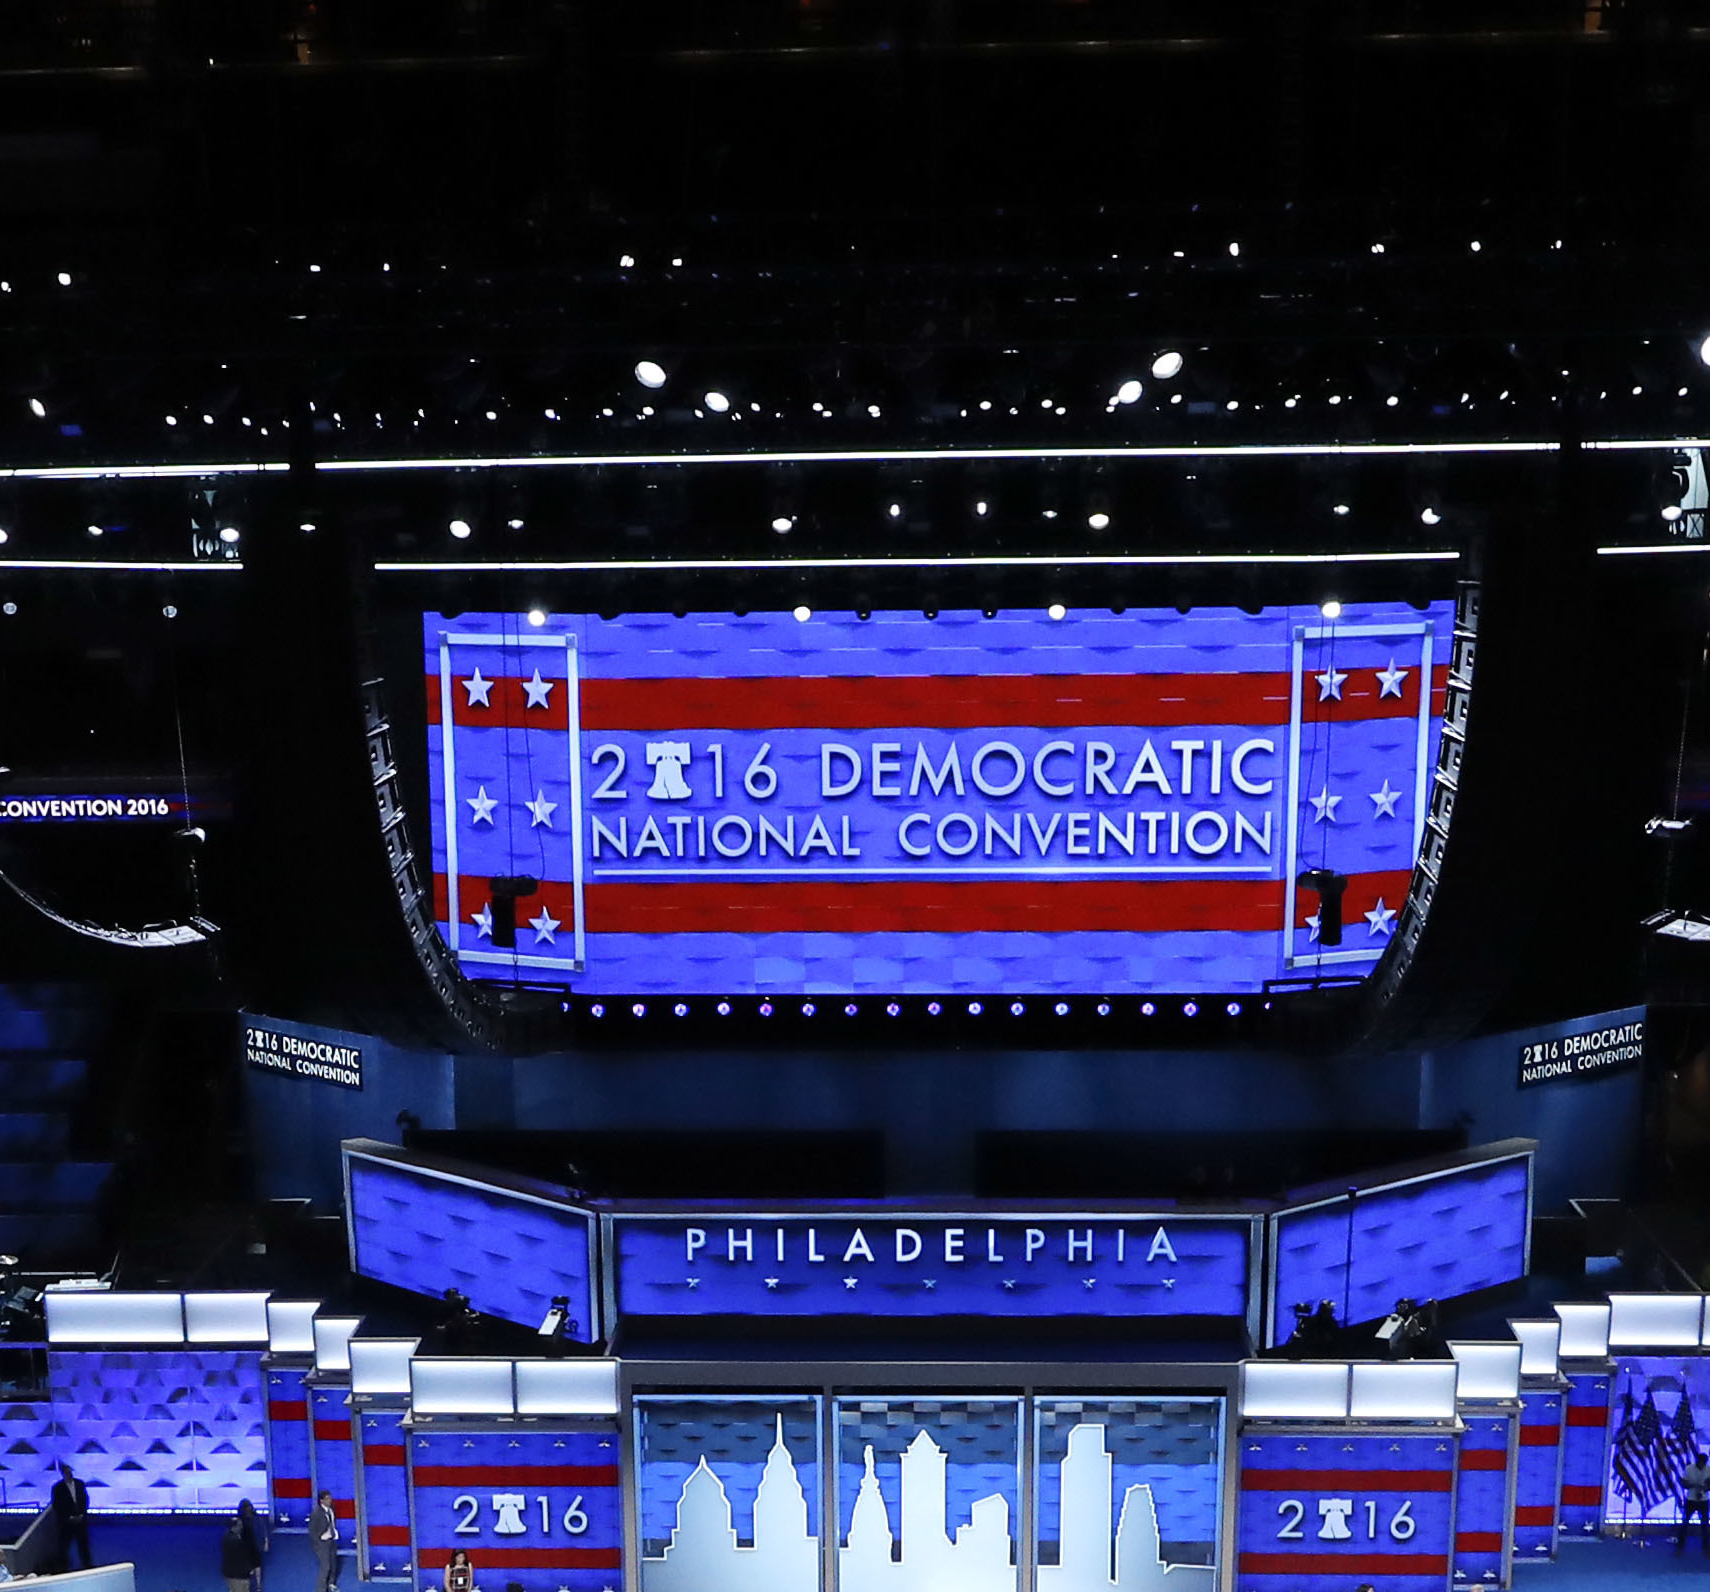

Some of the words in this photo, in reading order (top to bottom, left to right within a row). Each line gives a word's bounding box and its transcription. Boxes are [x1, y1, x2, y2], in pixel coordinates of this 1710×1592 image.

[821, 738, 1275, 797] DEMOCRATIC
[127, 799, 169, 815] 2016
[592, 814, 860, 859] NATIONAL
[898, 811, 1272, 858] CONVENTION
[282, 1036, 360, 1069] DEMOCRATIC
[1564, 1023, 1643, 1056] DEMOCRATIC
[247, 1049, 292, 1071] NATIONAL
[296, 1059, 360, 1085] CONVENTION
[1522, 1060, 1572, 1083] NATIONAL
[1577, 1045, 1642, 1070] CONVENTION
[686, 1227, 1178, 1263] PHILADELPHIA
